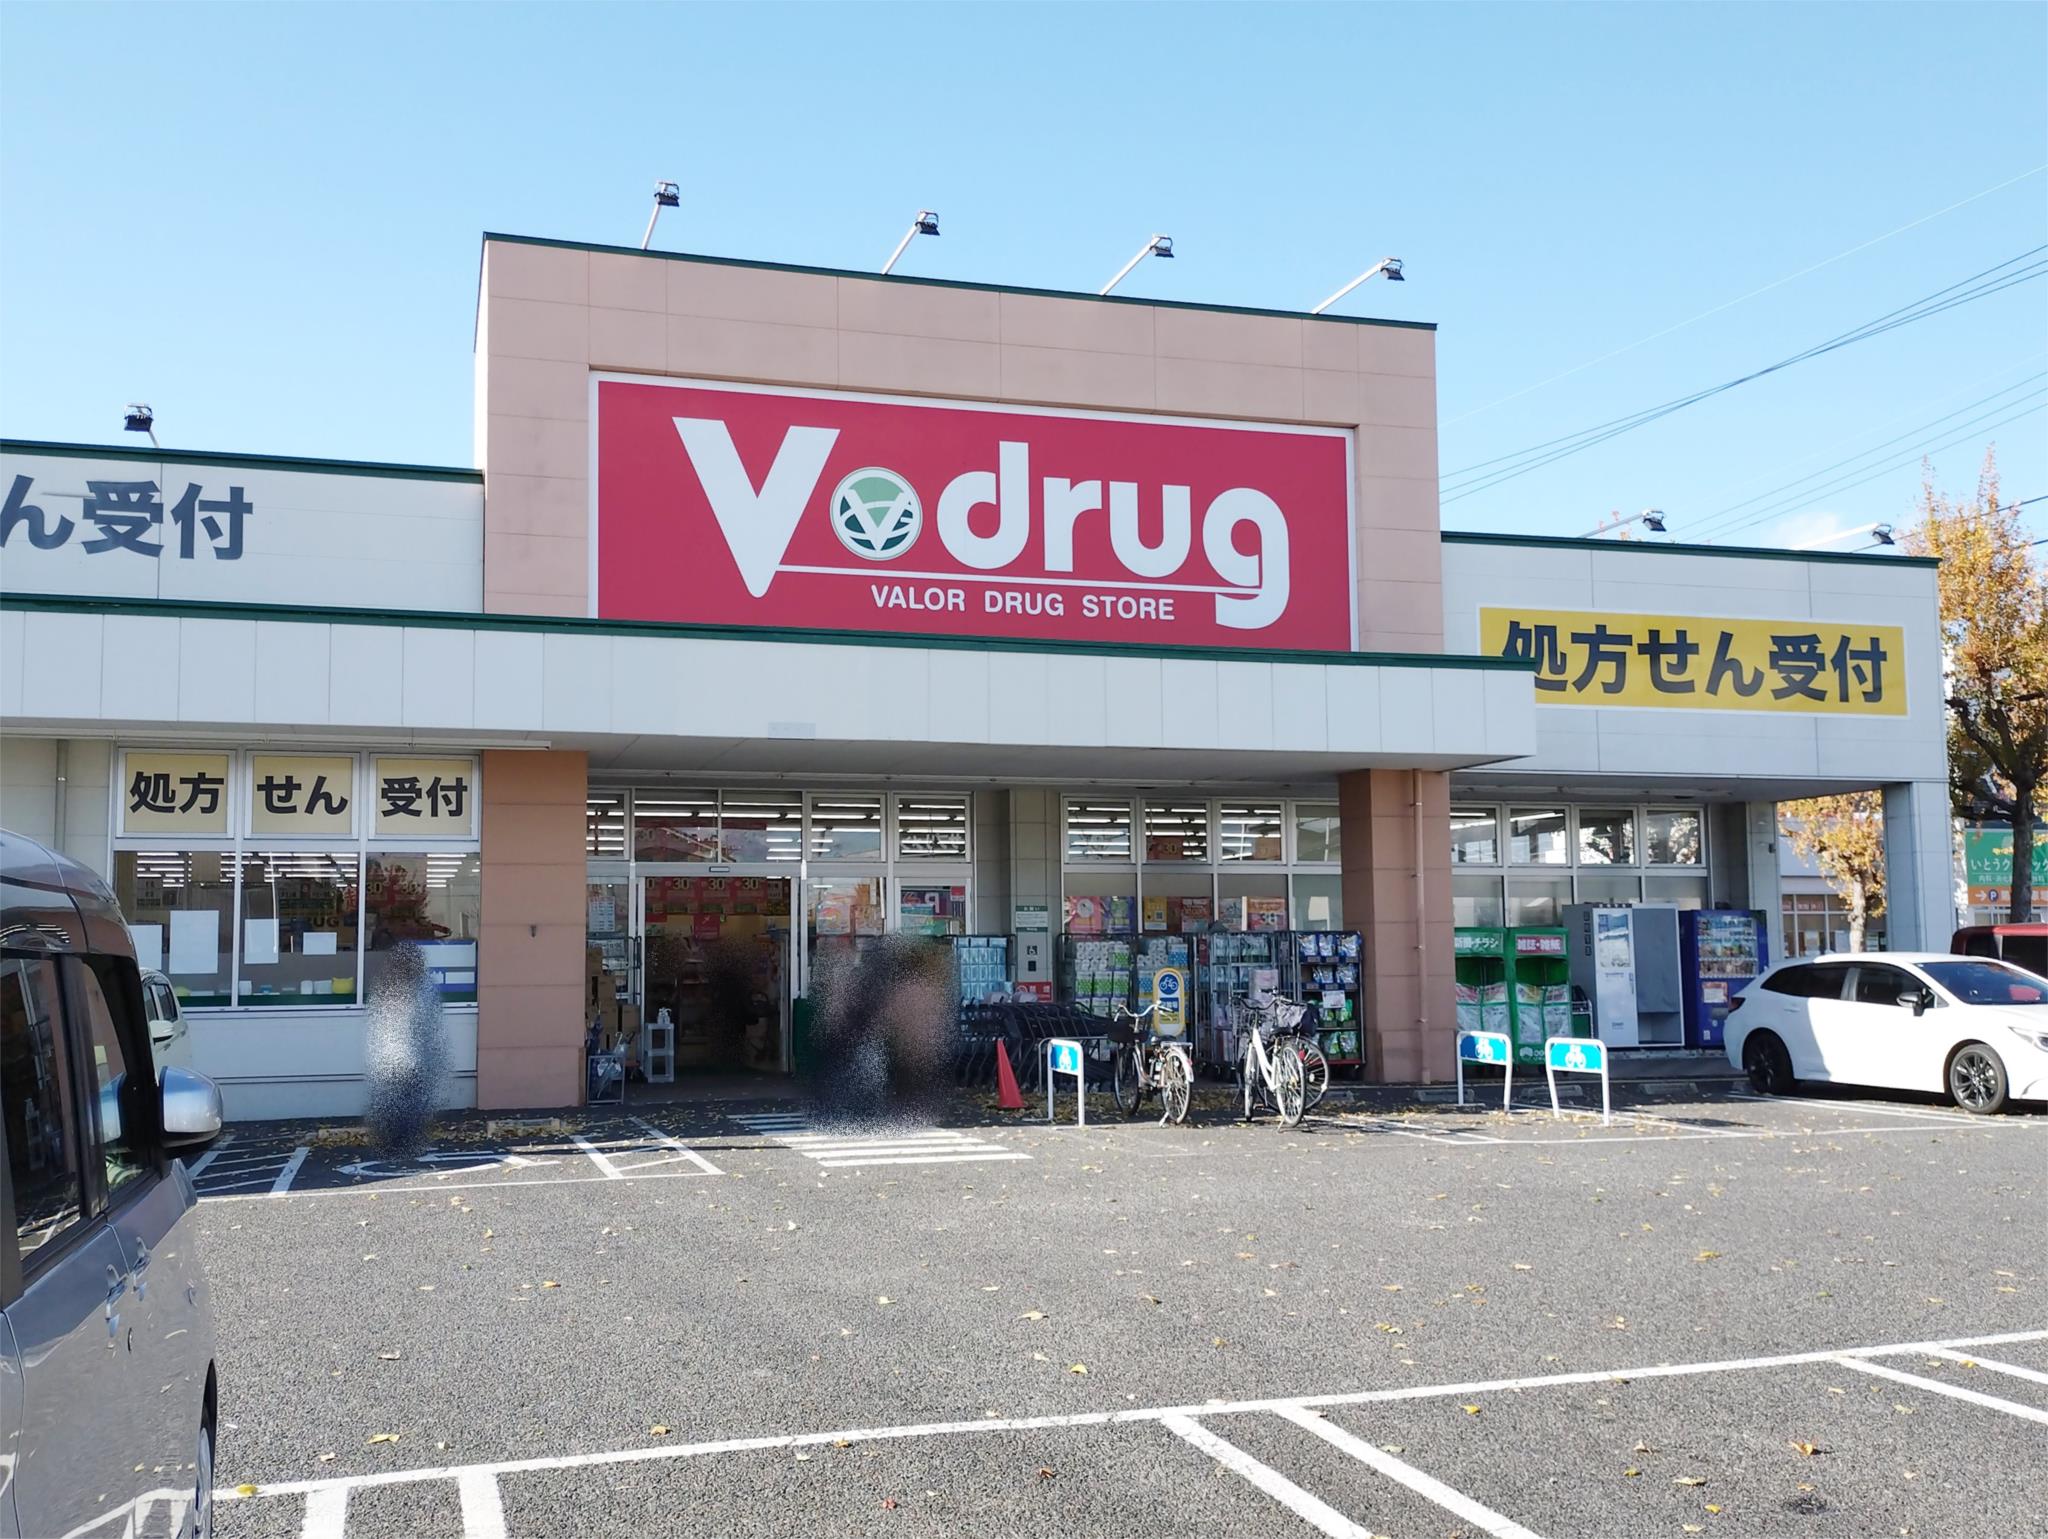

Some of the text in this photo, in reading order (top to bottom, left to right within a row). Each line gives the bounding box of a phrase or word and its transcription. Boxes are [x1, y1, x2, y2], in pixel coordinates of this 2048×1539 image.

[0, 474, 254, 561] ん受付
[871, 584, 1176, 620] VALOR DRUG STORE
[1502, 620, 1888, 703] 処方せん受付
[130, 771, 468, 818] 処方 せん 受付
[673, 879, 689, 890] 30
[709, 879, 725, 890] 30
[742, 878, 758, 890] 30
[1990, 891, 1997, 901] P
